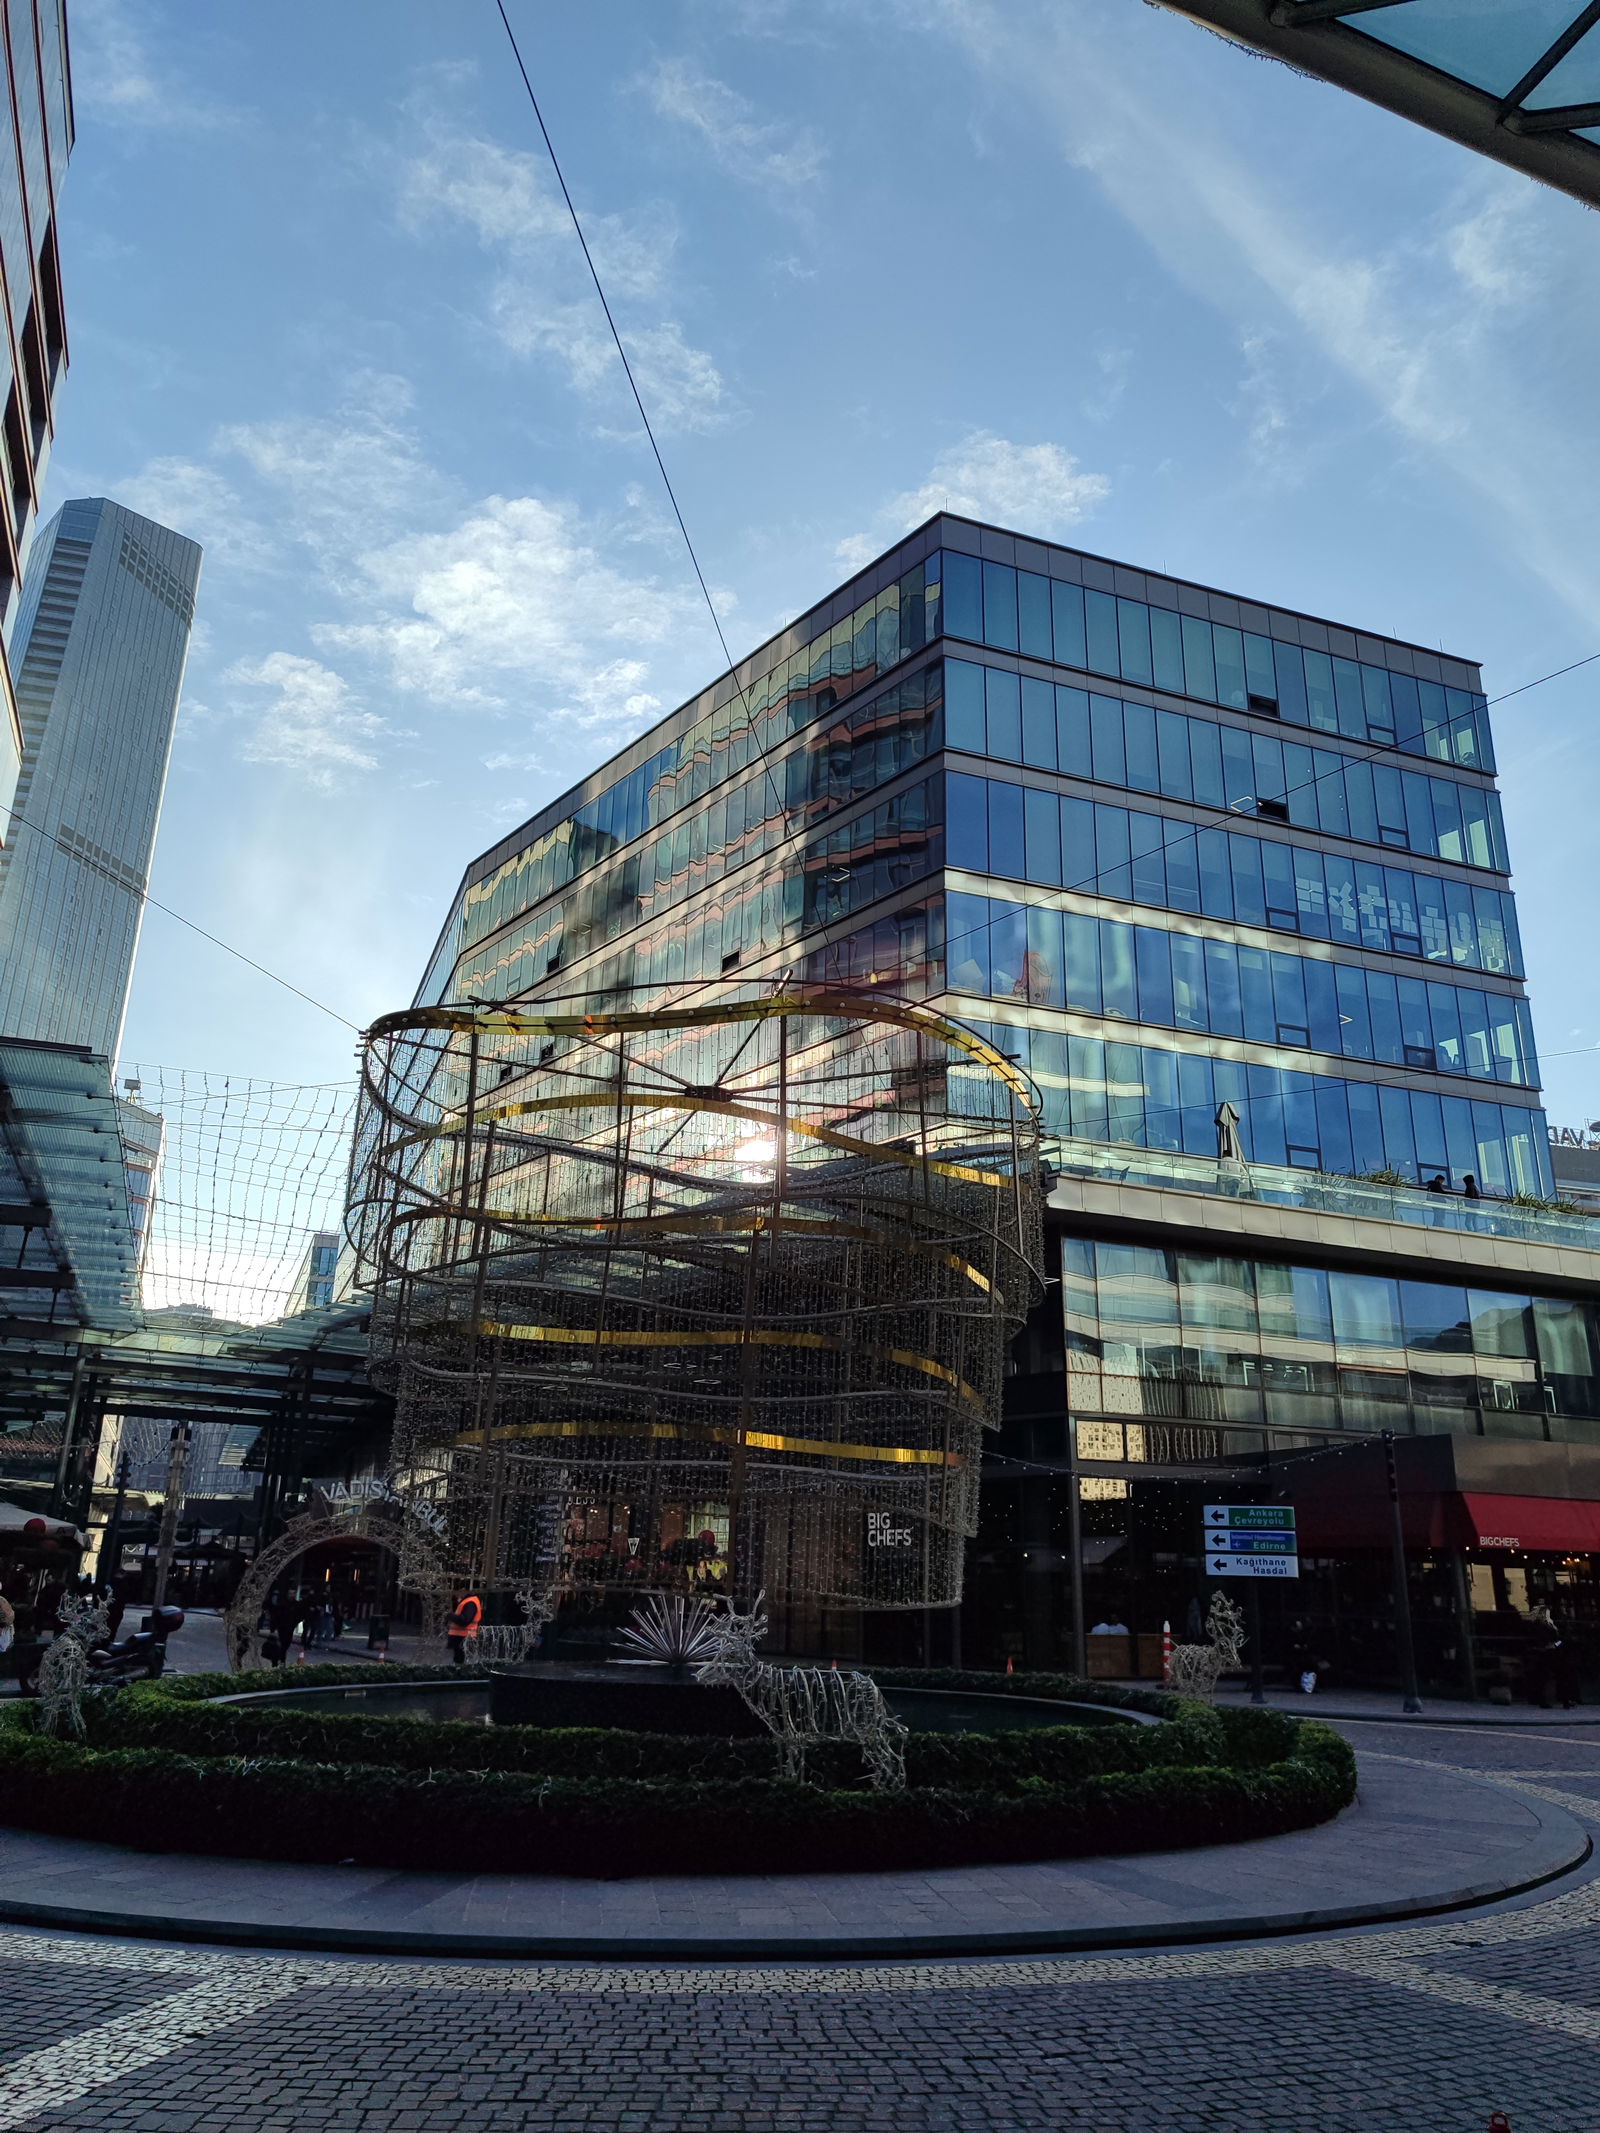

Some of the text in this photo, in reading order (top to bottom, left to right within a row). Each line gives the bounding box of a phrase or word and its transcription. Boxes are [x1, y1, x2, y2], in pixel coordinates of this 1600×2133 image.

[1248, 1509, 1284, 1517] Ankara
[867, 1511, 891, 1529] BIG
[1234, 1517, 1285, 1526] Çevreyolu
[867, 1529, 912, 1547] CHEFS
[1253, 1541, 1286, 1550] Edirne
[1253, 1567, 1287, 1575] Hasdal
